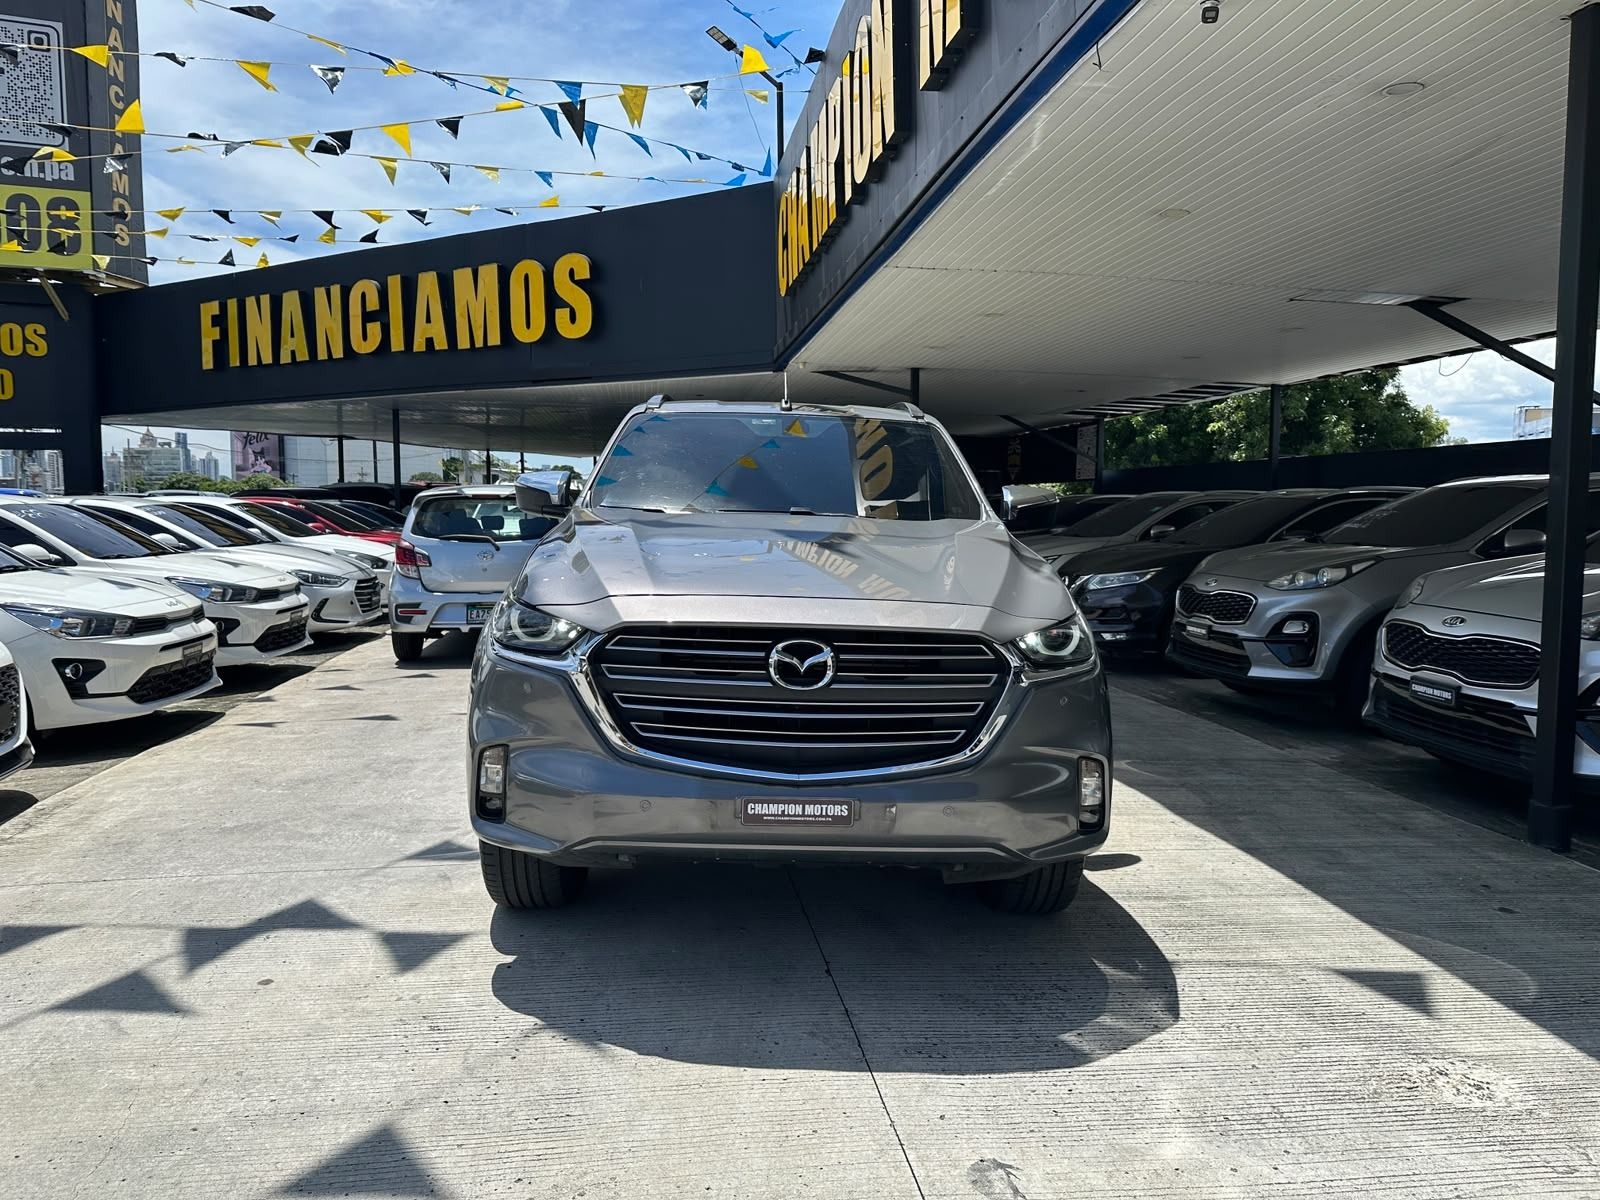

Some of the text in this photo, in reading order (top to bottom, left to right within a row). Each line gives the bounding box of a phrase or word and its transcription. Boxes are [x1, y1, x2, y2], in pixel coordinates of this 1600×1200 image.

[777, 0, 896, 297] CHAMPION
[0, 322, 49, 357] OS
[199, 252, 593, 371] FINANCIAMOS
[747, 803, 849, 816] CHAMPION MOTORS
